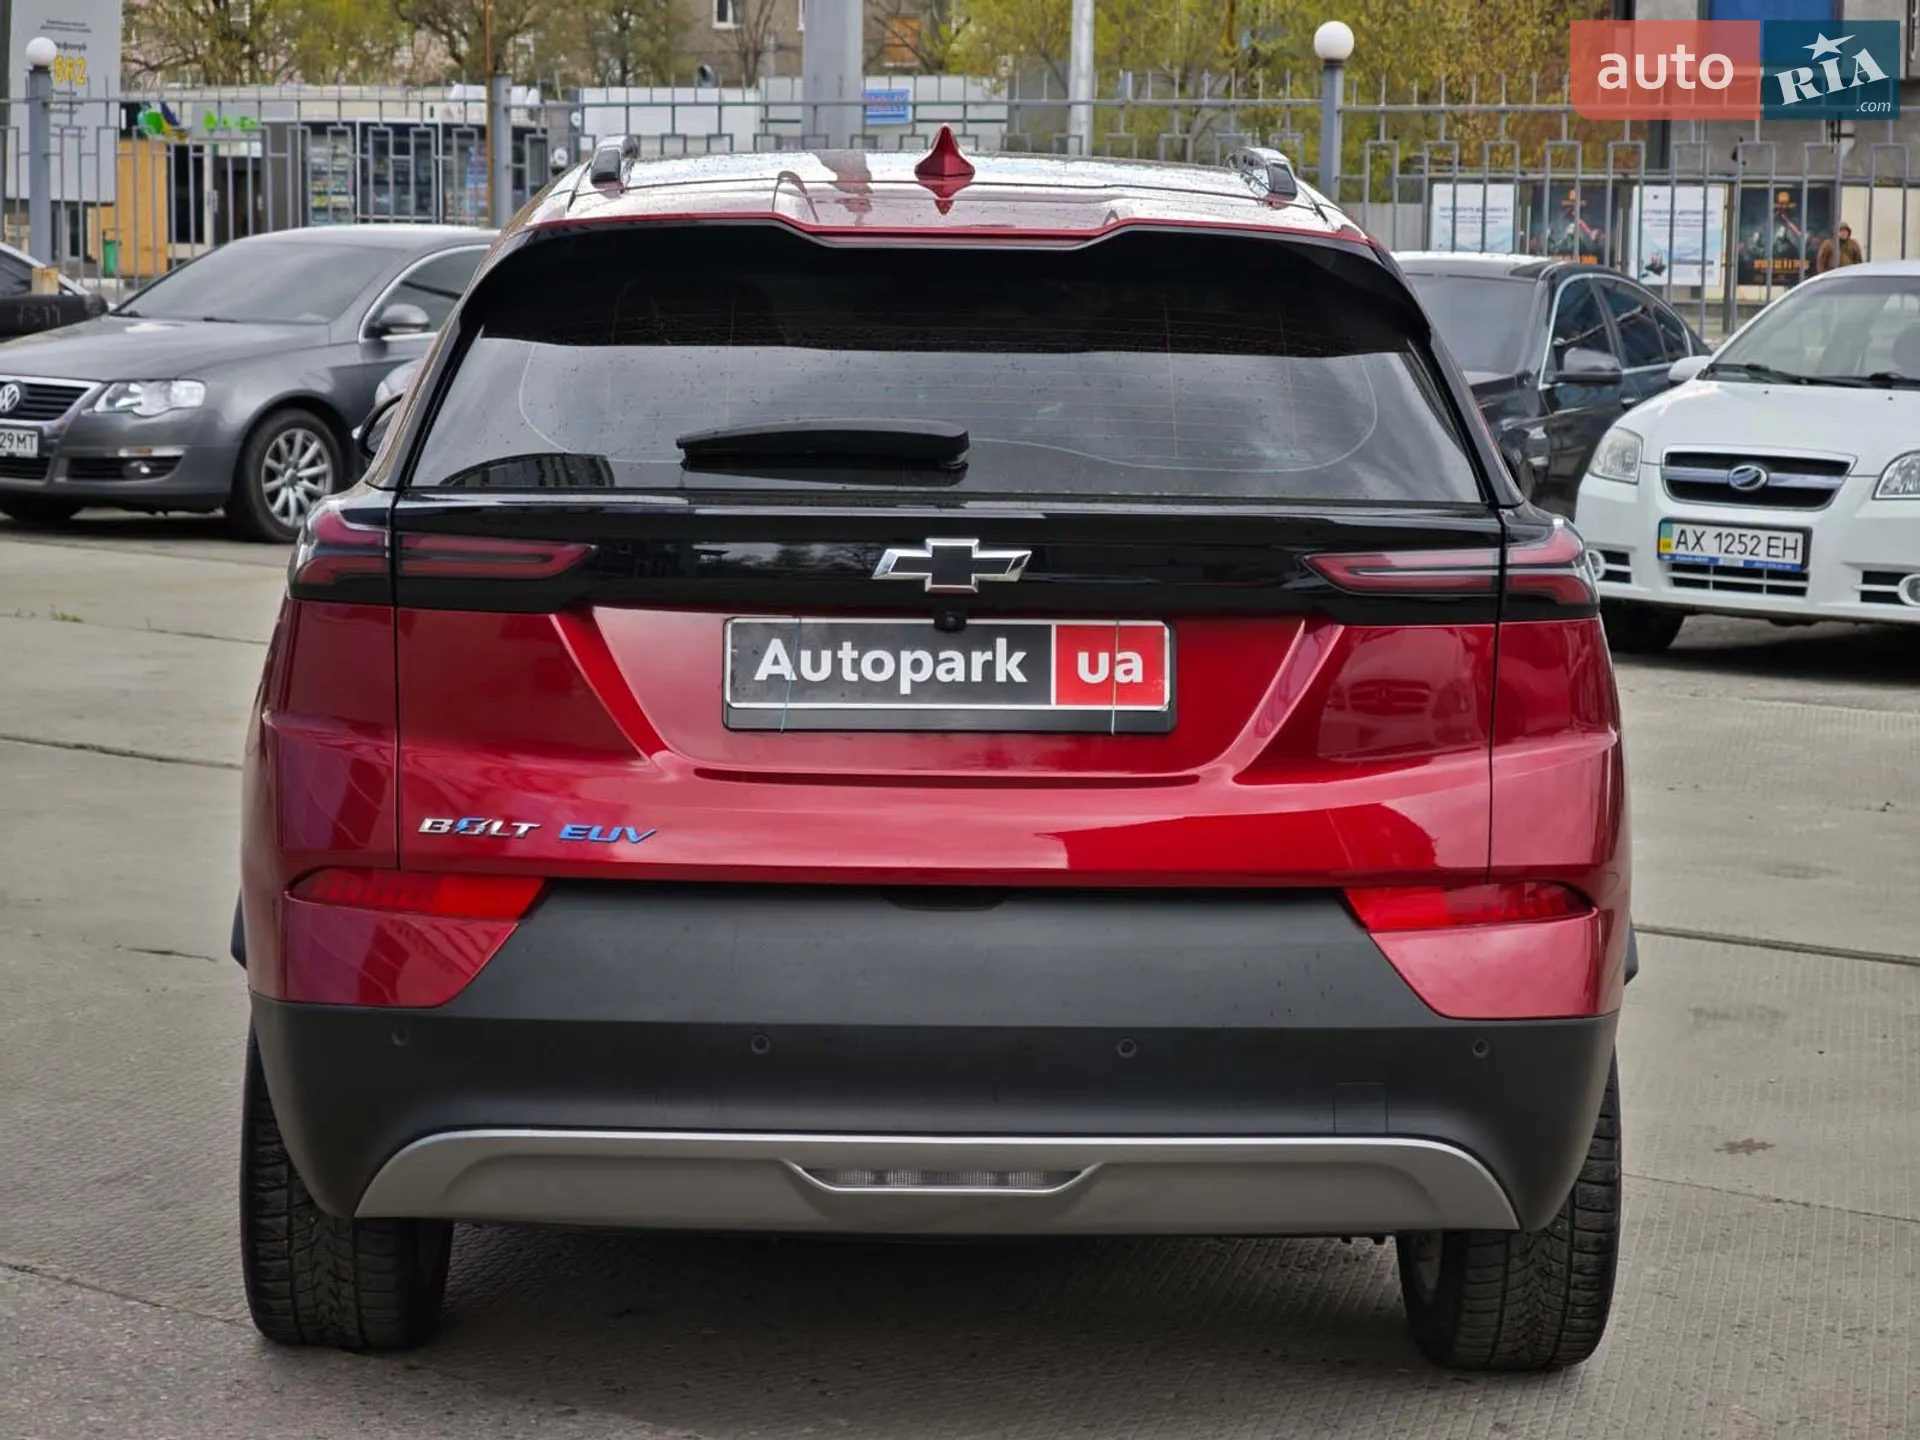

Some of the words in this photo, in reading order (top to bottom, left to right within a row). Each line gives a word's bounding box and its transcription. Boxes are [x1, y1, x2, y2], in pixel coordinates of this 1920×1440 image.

[17, 433, 37, 451] MT
[1675, 528, 1707, 553] AX
[1713, 531, 1762, 557] 1252
[1766, 536, 1799, 560] EH
[754, 637, 1027, 695] Autopark
[1076, 650, 1144, 685] ua
[417, 816, 541, 839] BOLT
[558, 823, 658, 845] EUV
